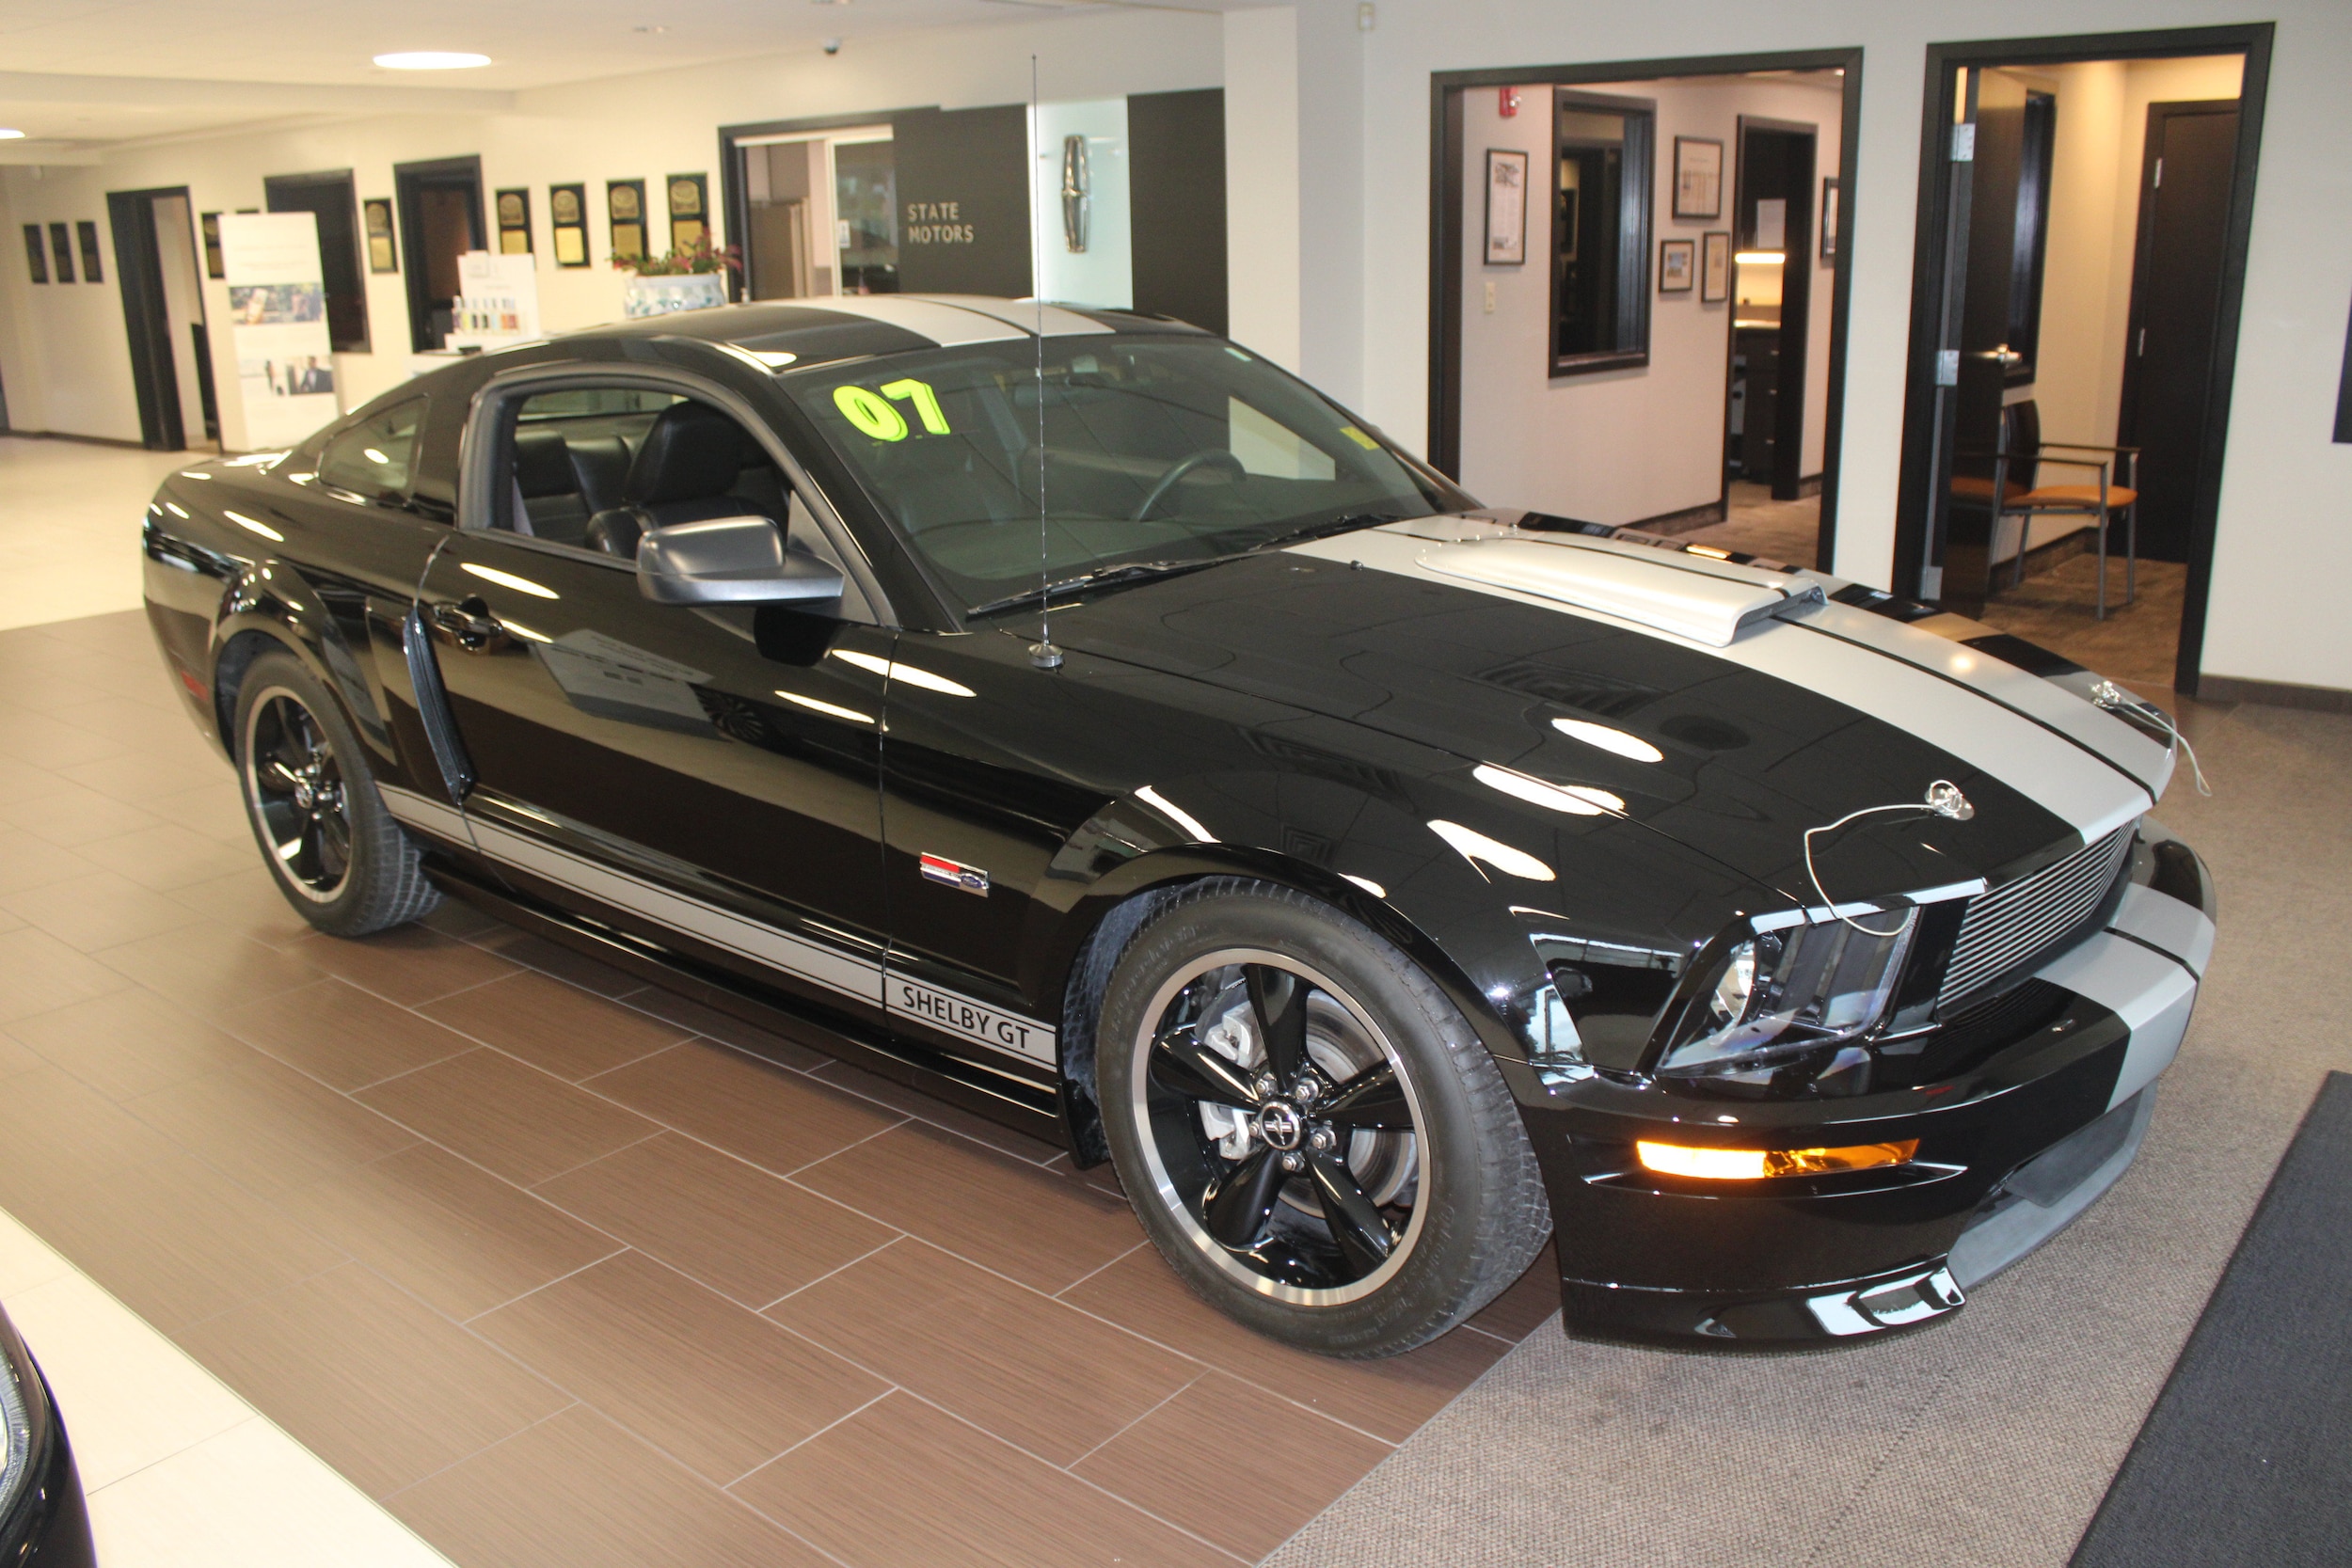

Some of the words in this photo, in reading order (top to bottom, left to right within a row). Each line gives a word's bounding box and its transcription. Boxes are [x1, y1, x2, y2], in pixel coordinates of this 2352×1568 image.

[908, 202, 959, 222] STATE
[909, 225, 974, 244] MOTORS
[834, 378, 951, 442] 07
[903, 986, 990, 1035] SHELBY
[997, 1022, 1029, 1049] GT
